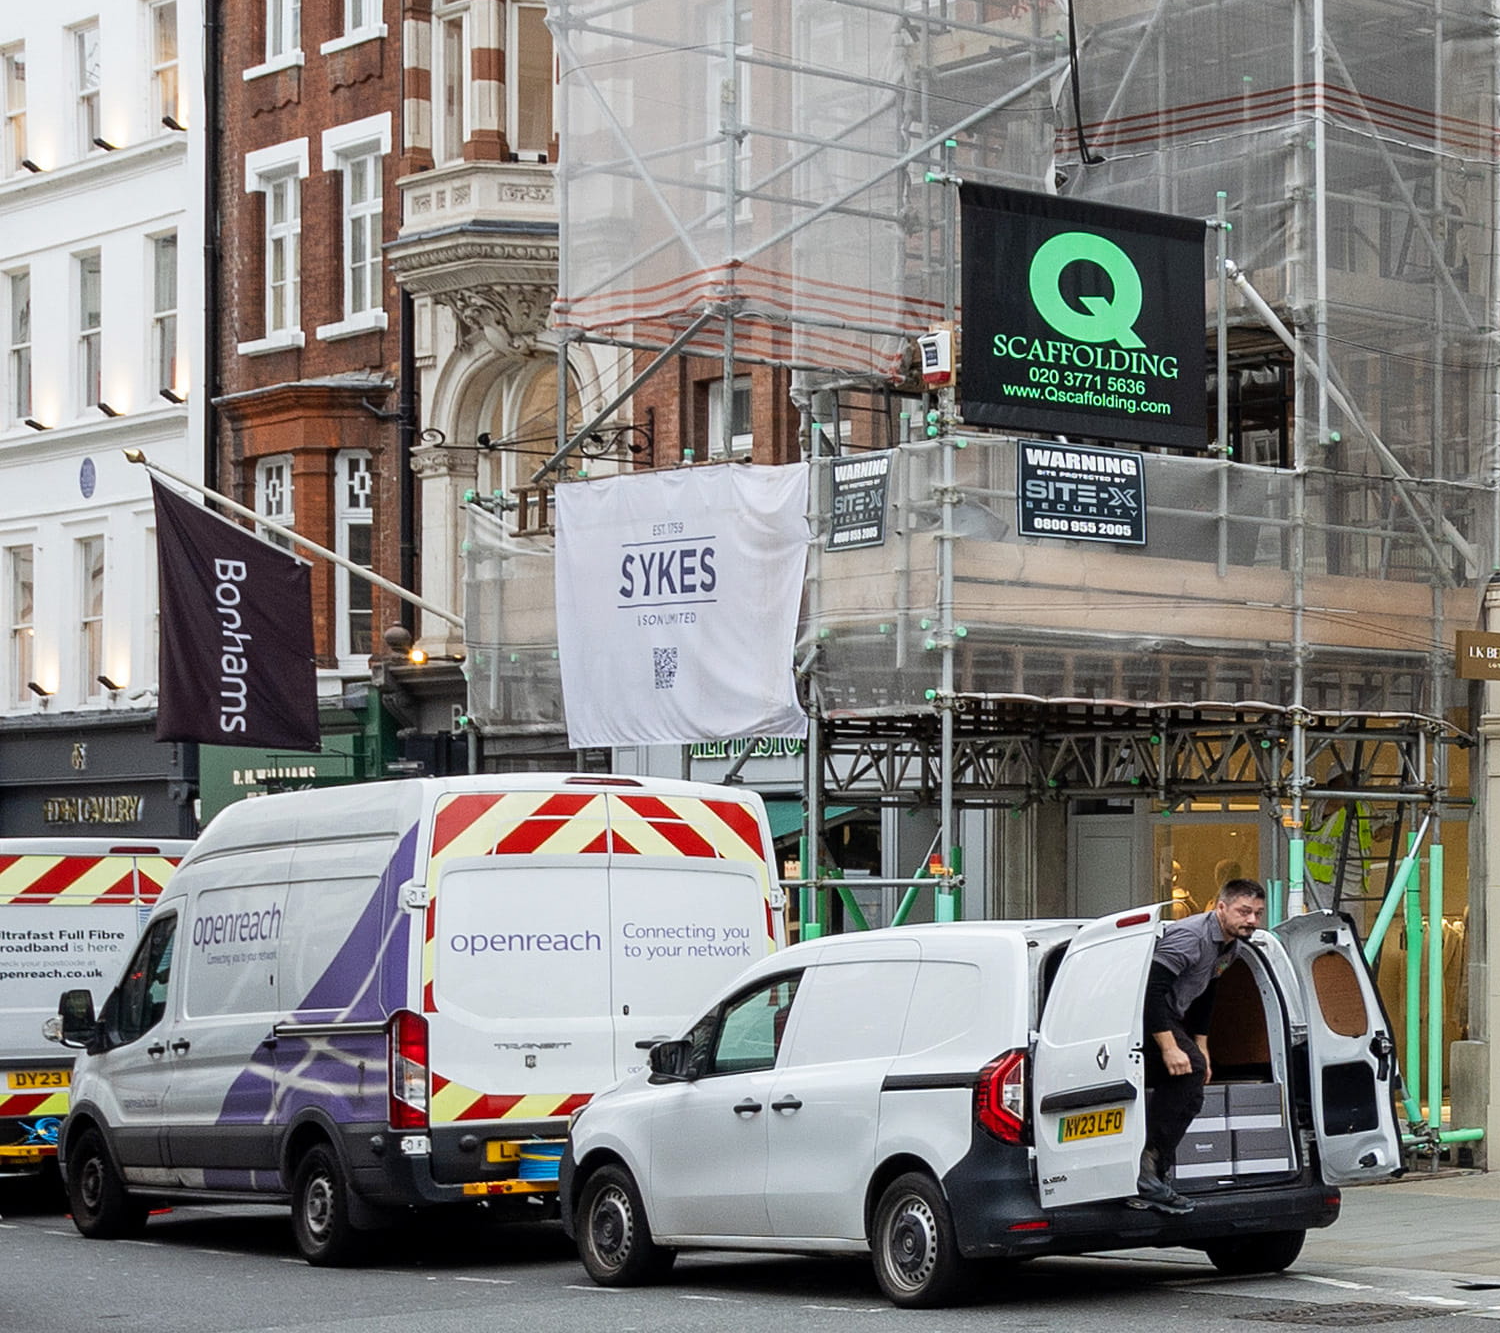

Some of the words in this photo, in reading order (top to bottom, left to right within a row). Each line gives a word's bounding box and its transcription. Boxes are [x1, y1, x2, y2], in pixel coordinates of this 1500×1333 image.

[1029, 231, 1147, 349] Q
[993, 333, 1179, 379] SCAFFOLDING
[1029, 366, 1060, 384] 020
[1063, 371, 1102, 389] 3771
[1107, 376, 1146, 395] 5636
[1002, 383, 1172, 415] www.Qscaffolding.com
[834, 458, 889, 483] WARNING
[1025, 447, 1138, 476] WARNING
[1025, 479, 1138, 508] SITE-X
[1025, 500, 1138, 518] SECURITY
[1033, 517, 1069, 531] 0800
[1070, 520, 1097, 533] 955
[1098, 523, 1132, 537] 2005
[618, 546, 717, 598] SYKES
[214, 558, 252, 733] Bonhams
[1469, 645, 1485, 659] LK
[58, 929, 85, 941] Full
[89, 929, 126, 941] Fibre
[193, 901, 282, 953] openreach
[622, 922, 716, 942] Connecting
[722, 927, 750, 942] you
[73, 942, 84, 953] is
[87, 942, 122, 953] here.
[450, 929, 602, 957] openreach
[624, 943, 642, 958] to
[647, 945, 683, 961] your
[687, 941, 751, 958] network
[0, 968, 103, 981] penreach.co.uk
[15, 1072, 63, 1087] DY23
[1064, 1115, 1096, 1138] NV23
[1098, 1110, 1123, 1133] LFO
